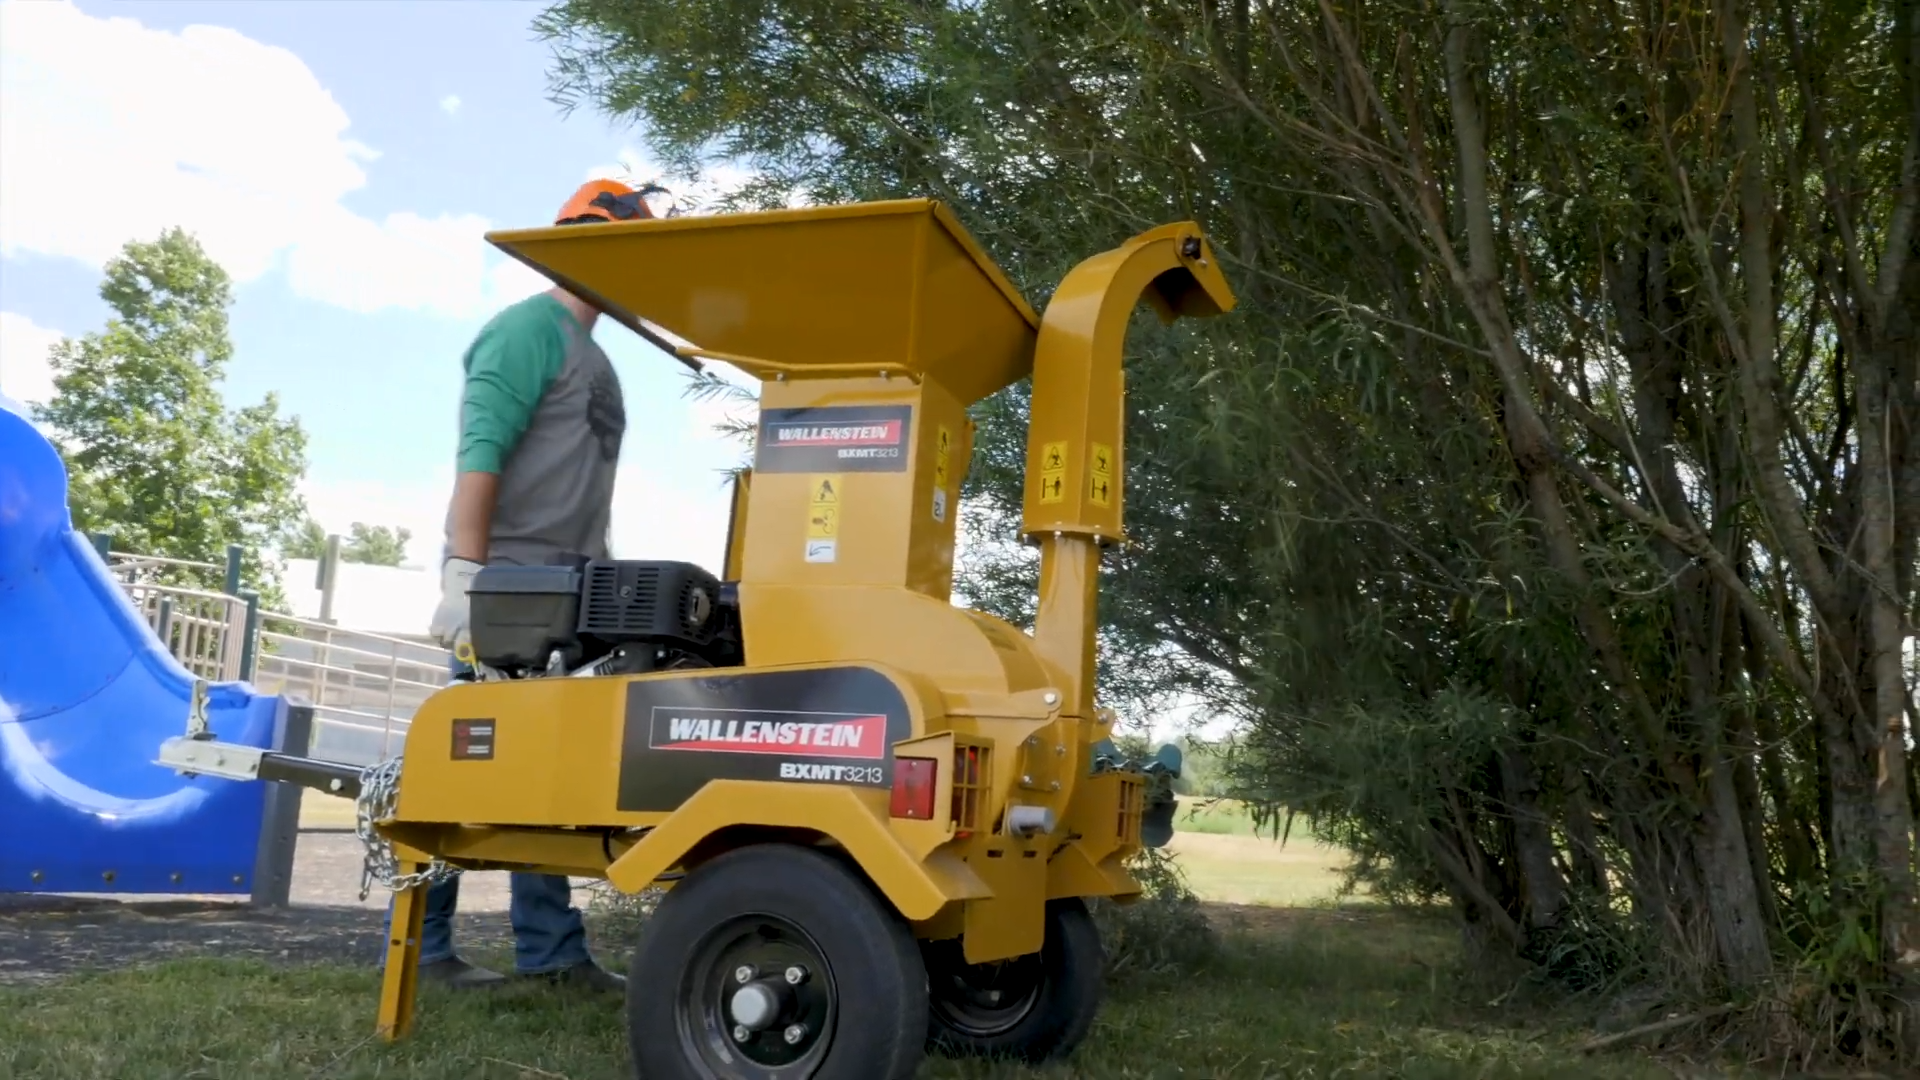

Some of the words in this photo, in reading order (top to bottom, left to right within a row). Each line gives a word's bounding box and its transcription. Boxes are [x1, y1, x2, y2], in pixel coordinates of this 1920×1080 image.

[778, 426, 888, 441] WALLENSTEIN
[837, 448, 898, 459] BXMT3213
[669, 718, 863, 748] WALLENSTEIN
[780, 763, 883, 783] BXMT3213
